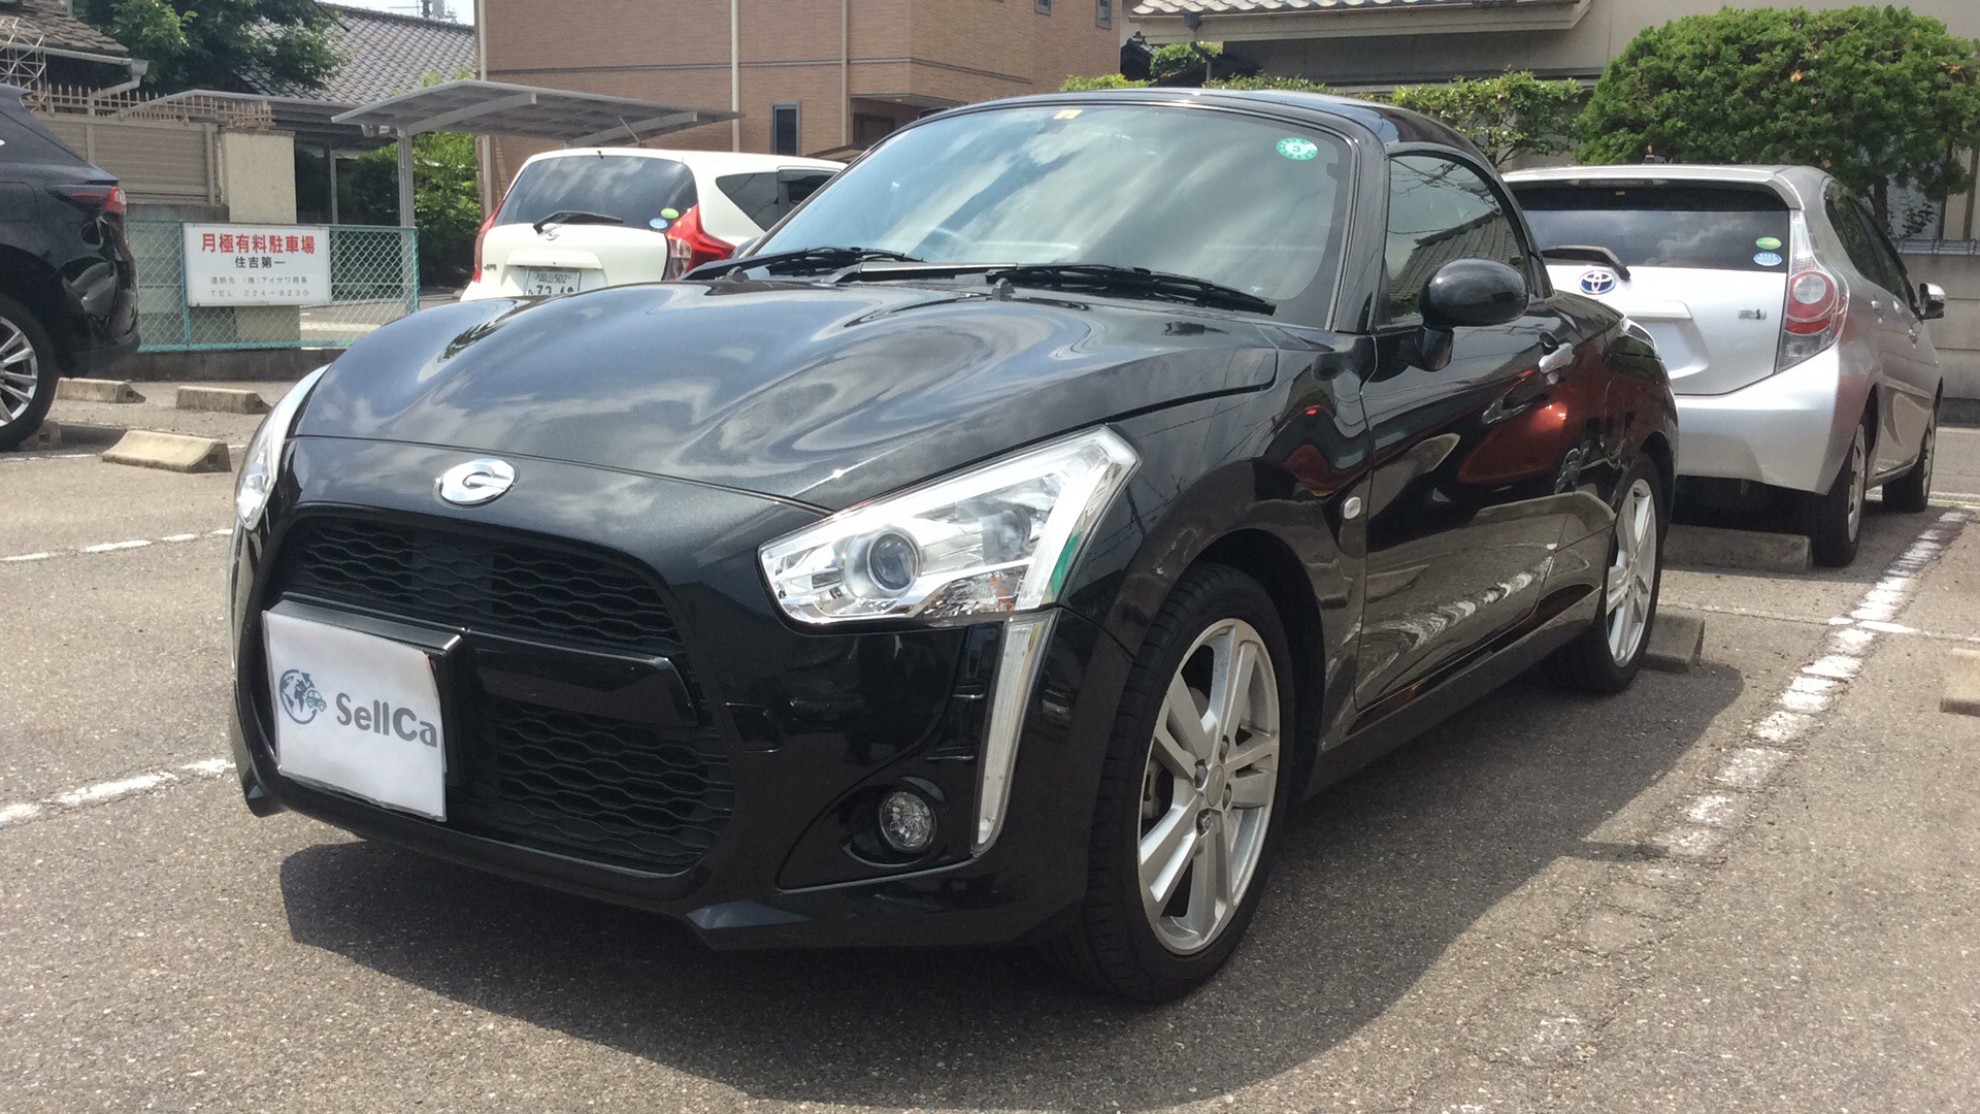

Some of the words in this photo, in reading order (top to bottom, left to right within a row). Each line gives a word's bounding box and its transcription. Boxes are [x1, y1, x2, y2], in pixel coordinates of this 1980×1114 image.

[202, 233, 315, 254] 月極有料駐車場
[235, 256, 286, 269] 住吉第一
[336, 692, 438, 748] SellCa
